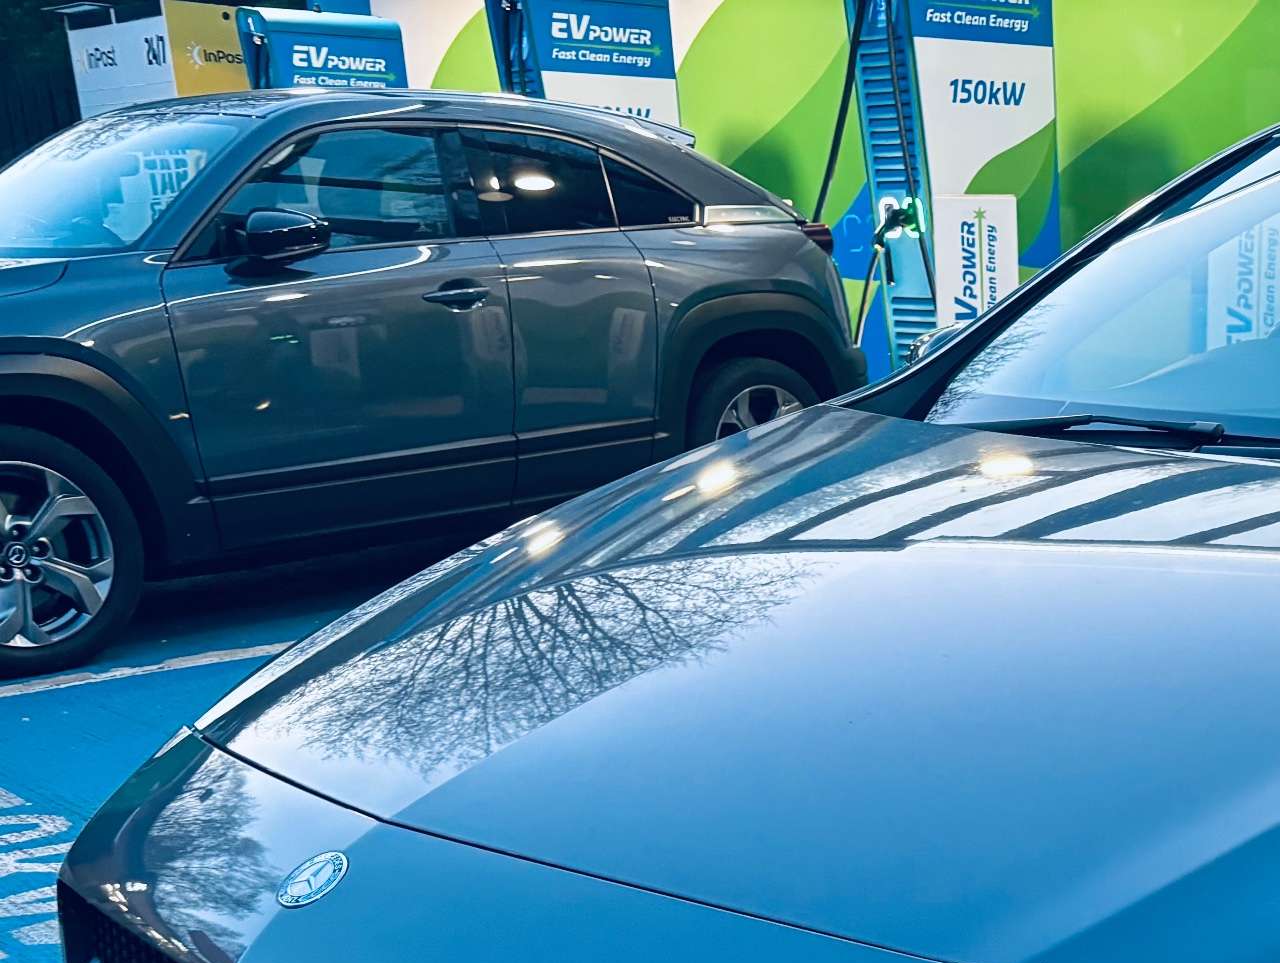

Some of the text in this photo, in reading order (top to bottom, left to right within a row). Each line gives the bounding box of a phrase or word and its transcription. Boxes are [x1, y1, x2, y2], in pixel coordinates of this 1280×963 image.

[926, 9, 1029, 32] Fast Clean Energy
[204, 50, 244, 65] InPos
[552, 48, 651, 67] Fast Clean Energy
[293, 74, 316, 85] Fast
[317, 76, 348, 86] Clean
[950, 78, 1026, 106] 150kW
[986, 224, 998, 309] lean Energy
[1264, 228, 1280, 328] Clean Energy
